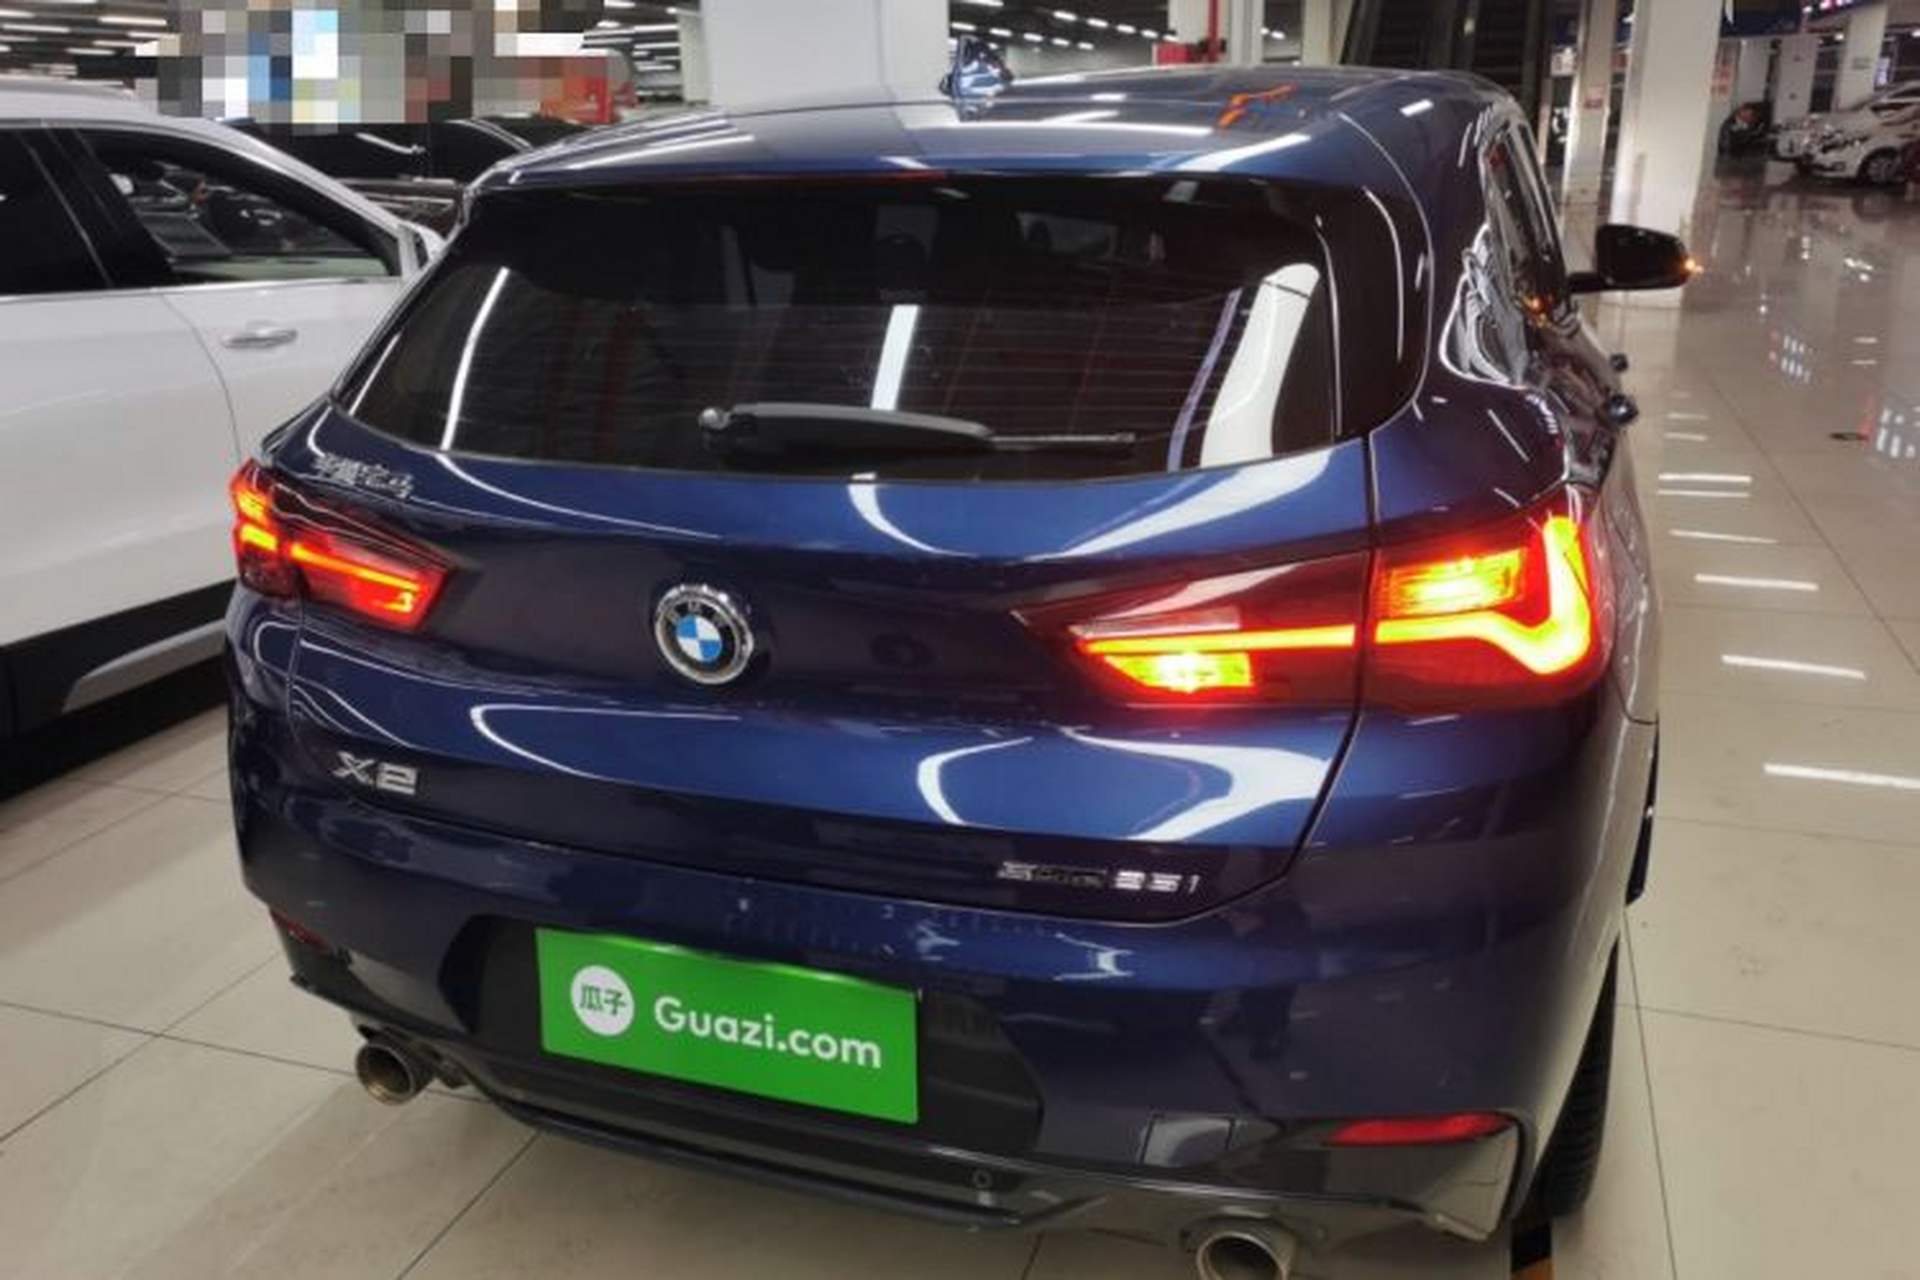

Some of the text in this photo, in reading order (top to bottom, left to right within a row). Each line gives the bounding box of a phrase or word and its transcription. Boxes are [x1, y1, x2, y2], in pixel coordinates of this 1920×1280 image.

[332, 750, 418, 796] X2
[579, 983, 628, 1016] 瓜子
[654, 995, 882, 1069] Guazi.com
